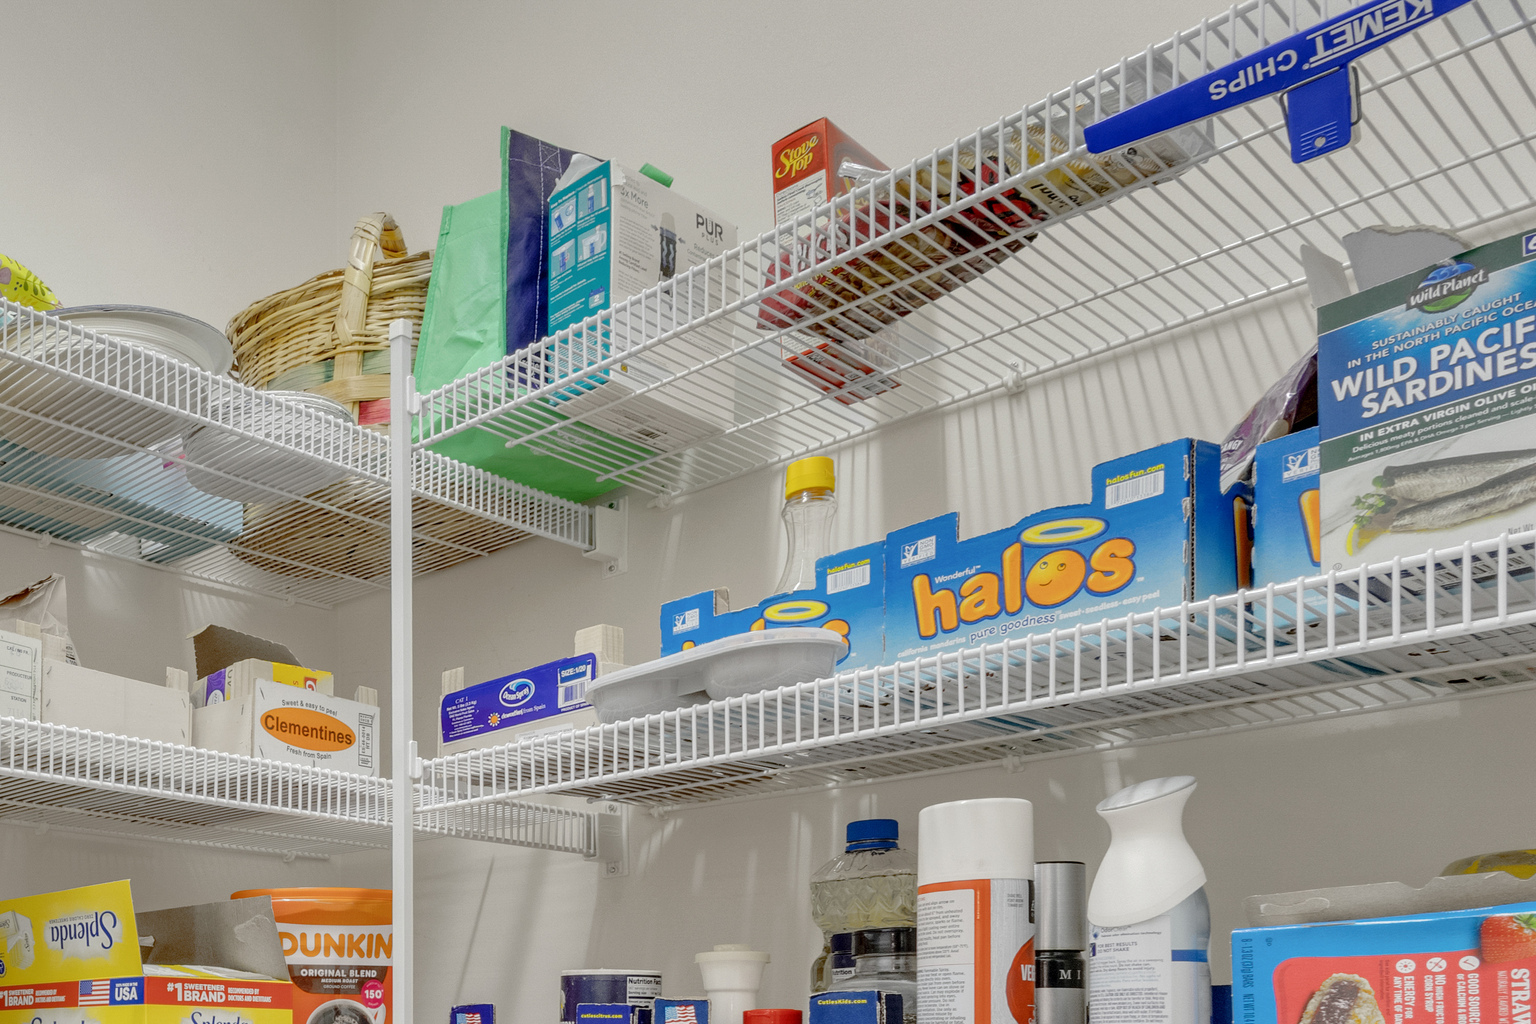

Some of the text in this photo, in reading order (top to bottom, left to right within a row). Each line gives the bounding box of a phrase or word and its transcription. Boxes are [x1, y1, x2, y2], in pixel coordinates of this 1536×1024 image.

[1208, 0, 1433, 101] KEMET CHIPS
[775, 135, 818, 178] Stove
[790, 152, 813, 178] Top
[630, 193, 649, 209] More
[1410, 269, 1485, 306] Wild Planet
[1371, 292, 1521, 350] SUSTAINABLY CAUGHT
[1347, 311, 1498, 369] IN THE NORTH PACIFIC
[1331, 356, 1417, 402] WILD
[1378, 388, 1517, 437] EXTRA VIRGIN OLIVE
[1352, 402, 1508, 453] Delicious portions cleaned and
[1106, 463, 1165, 486] halosfun.com
[912, 537, 1136, 639] halos
[934, 566, 976, 584] Wonderful
[970, 614, 1055, 644] pure goodness
[503, 686, 530, 700] Ocean Spray
[264, 714, 352, 745] Clementines
[286, 745, 302, 756] Fresh
[51, 910, 118, 950] Splenda
[300, 968, 377, 978] ORIGINAL BLEND
[628, 977, 653, 985] Nutrition
[1434, 974, 1446, 986] NO
[1468, 973, 1480, 995] GOOD
[9, 995, 34, 1007] BRAND
[115, 986, 138, 1001] USA
[167, 982, 226, 1003] #1 SWEETENER BRAND
[364, 989, 383, 999] 150
[1403, 975, 1415, 1006] ENERGY
[1457, 981, 1466, 1008] CALCIUM
